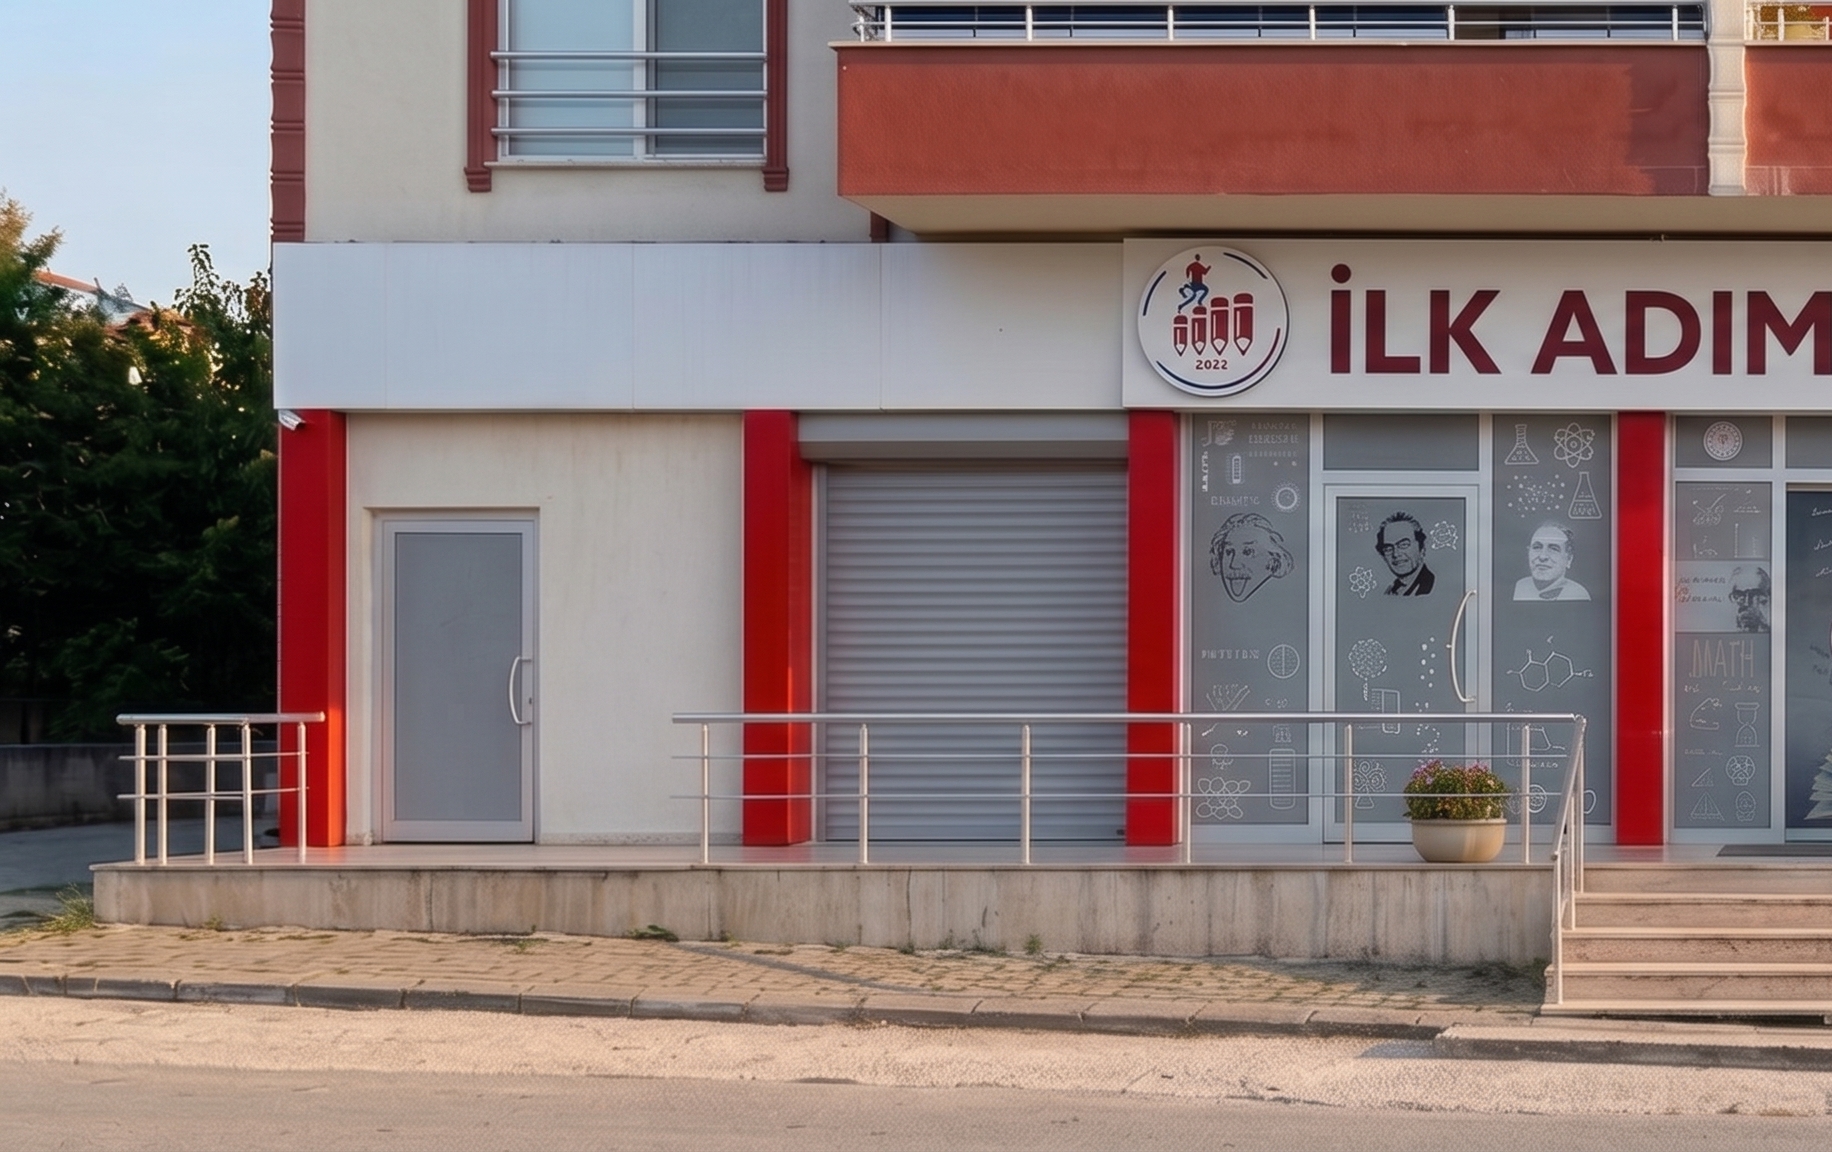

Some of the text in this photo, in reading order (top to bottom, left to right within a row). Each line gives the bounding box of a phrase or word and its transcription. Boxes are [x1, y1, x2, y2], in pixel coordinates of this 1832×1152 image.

[1330, 263, 1501, 374] İLK
[1195, 359, 1228, 370] 2022
[1689, 639, 1754, 678] MATH
